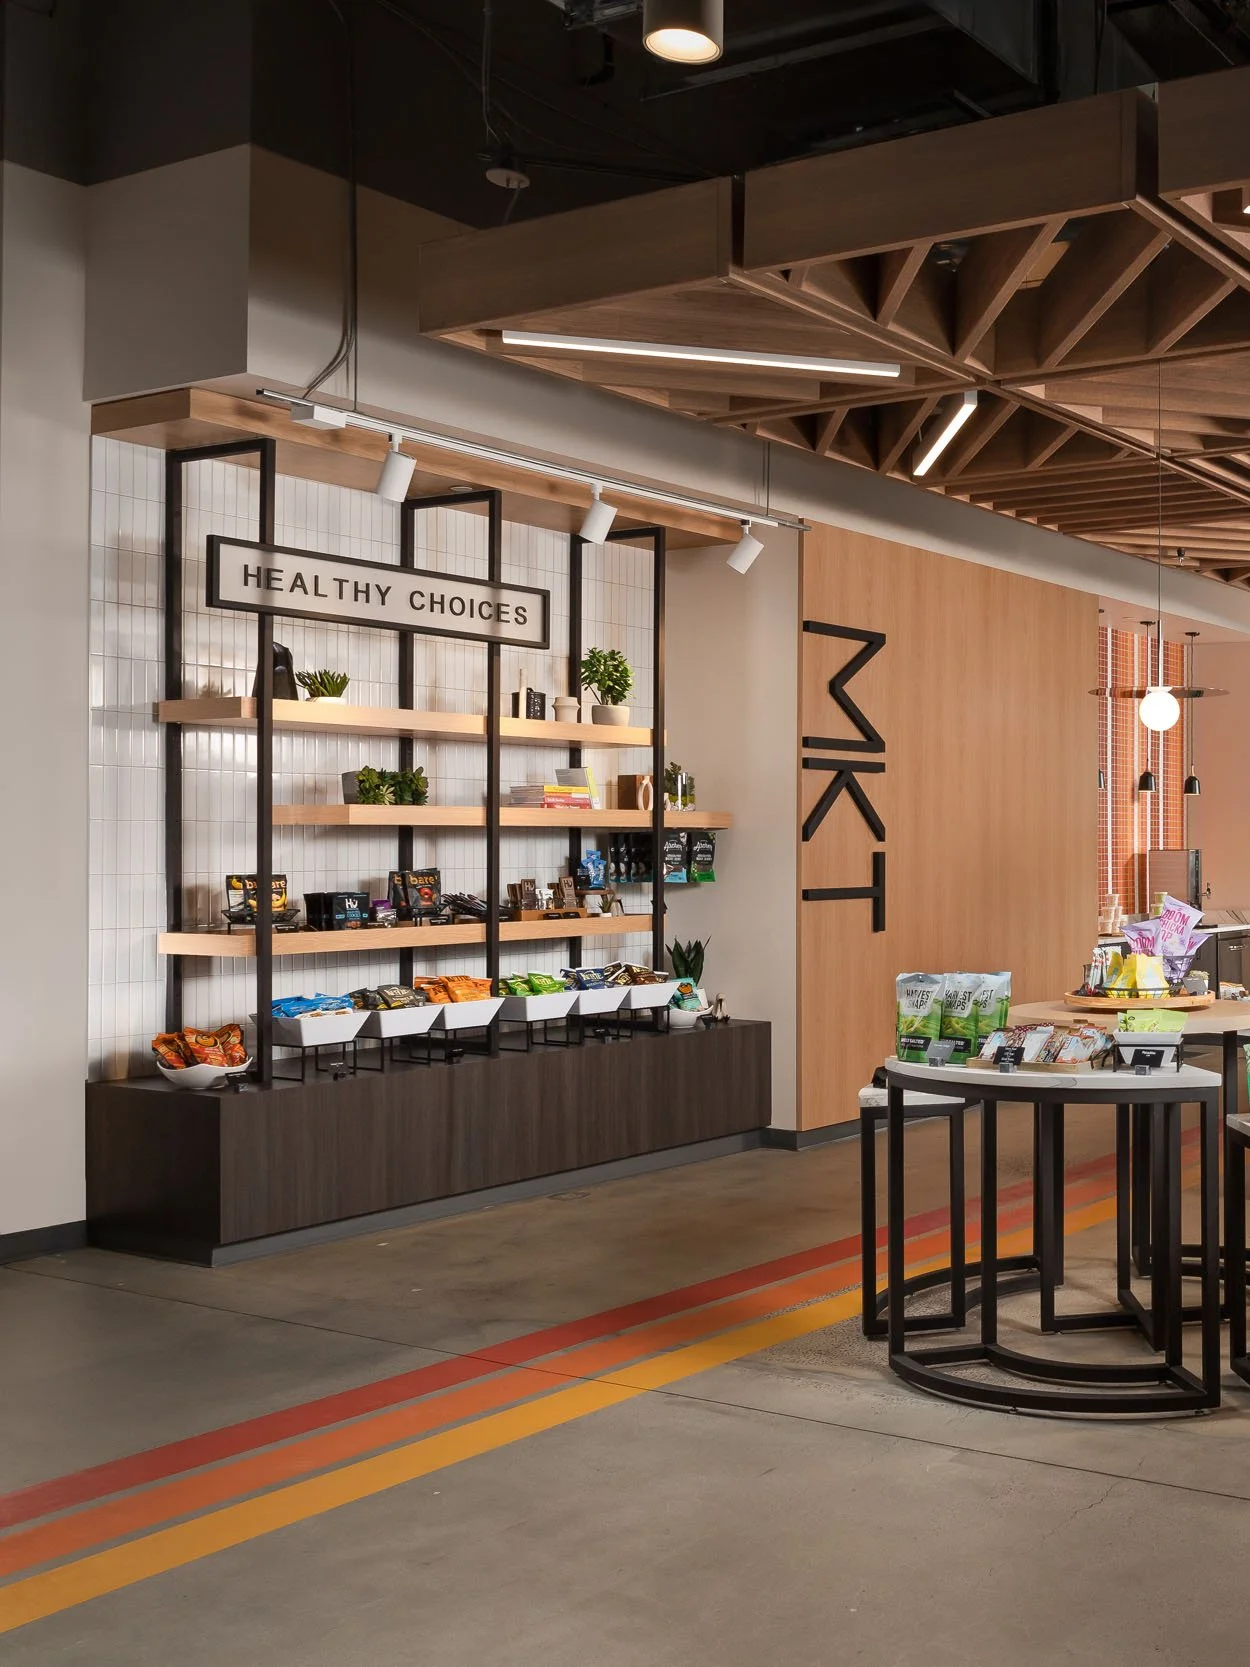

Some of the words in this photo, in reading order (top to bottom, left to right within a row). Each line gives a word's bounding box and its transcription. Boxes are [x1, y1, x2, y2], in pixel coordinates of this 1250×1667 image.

[243, 564, 392, 606] HEALTHY
[409, 590, 528, 625] CHOICES
[802, 620, 886, 932] MKT
[906, 989, 933, 1000] HARVEST
[944, 989, 972, 1002] HARVEST
[944, 1000, 966, 1011] SNAPS
